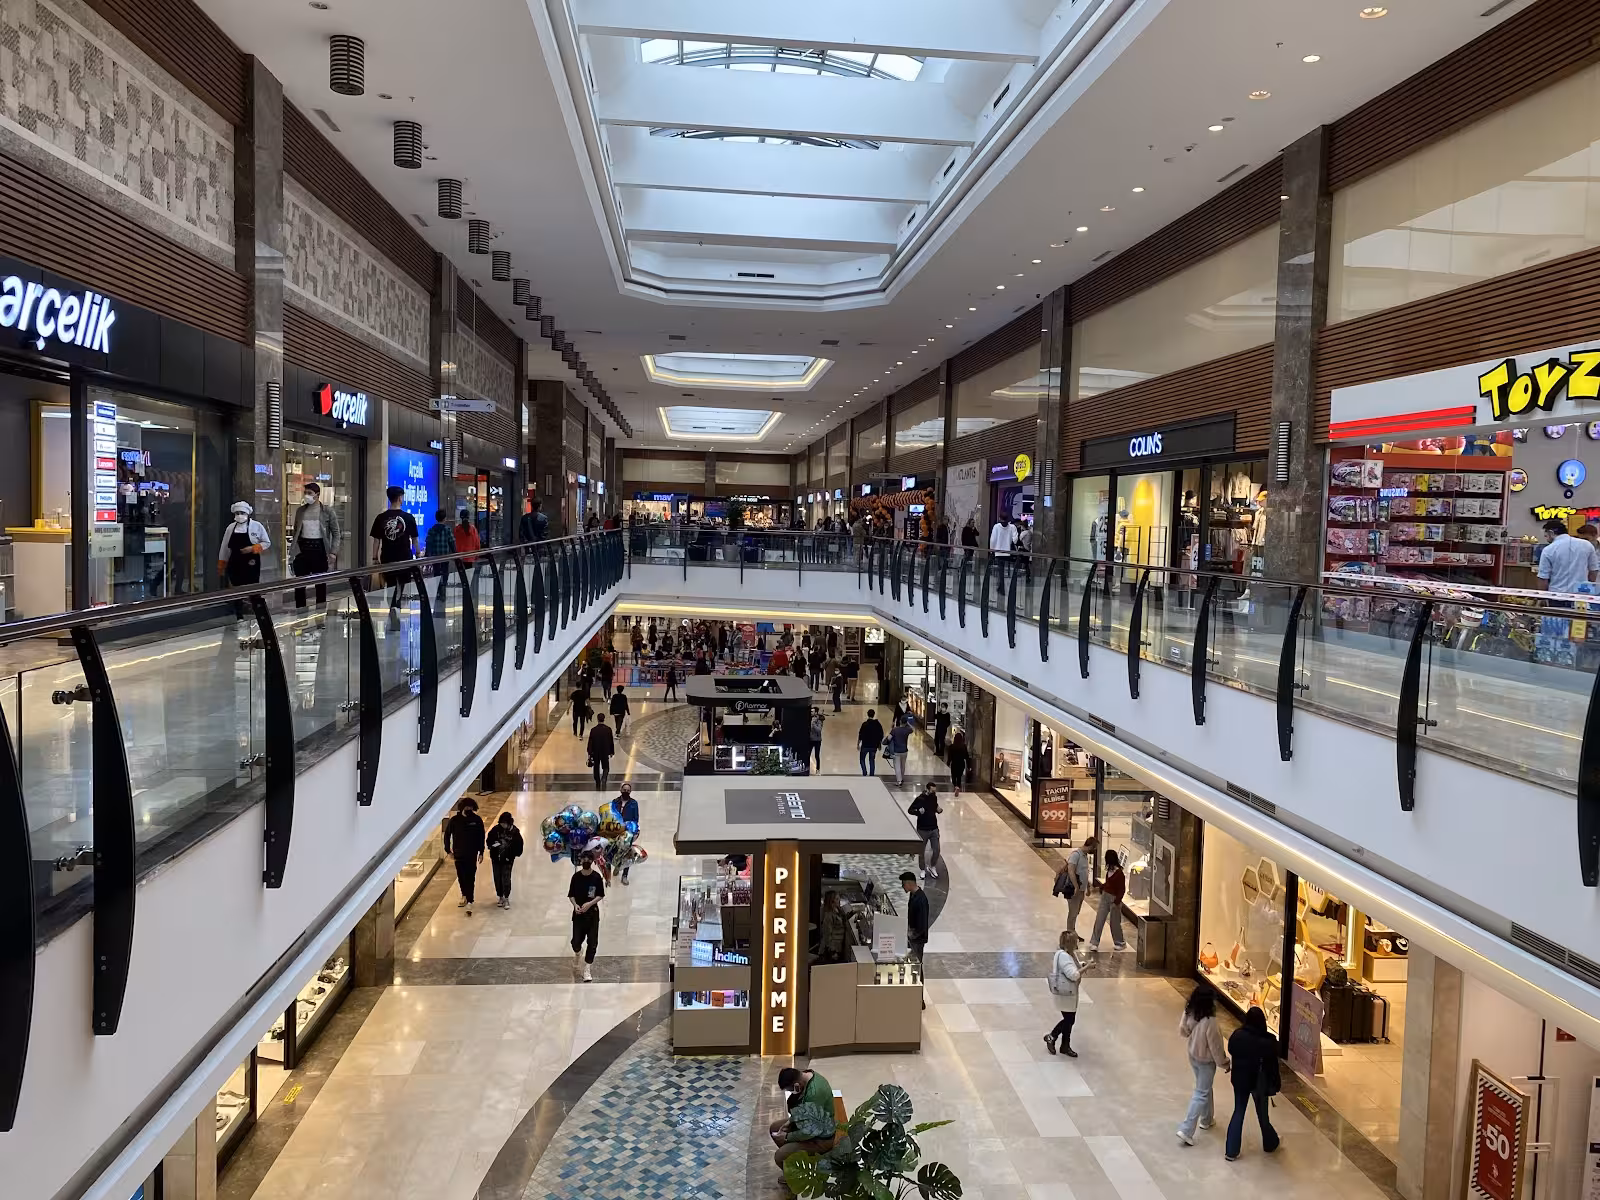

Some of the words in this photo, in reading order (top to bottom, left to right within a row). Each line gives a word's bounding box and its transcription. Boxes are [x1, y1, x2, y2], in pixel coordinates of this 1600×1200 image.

[0, 276, 116, 354] arçelik
[332, 390, 368, 429] arçelik
[1130, 432, 1162, 457] COLIN'S
[408, 460, 424, 482] Arçelik
[1045, 786, 1069, 795] TAKIM
[770, 867, 789, 1033] PERFUME
